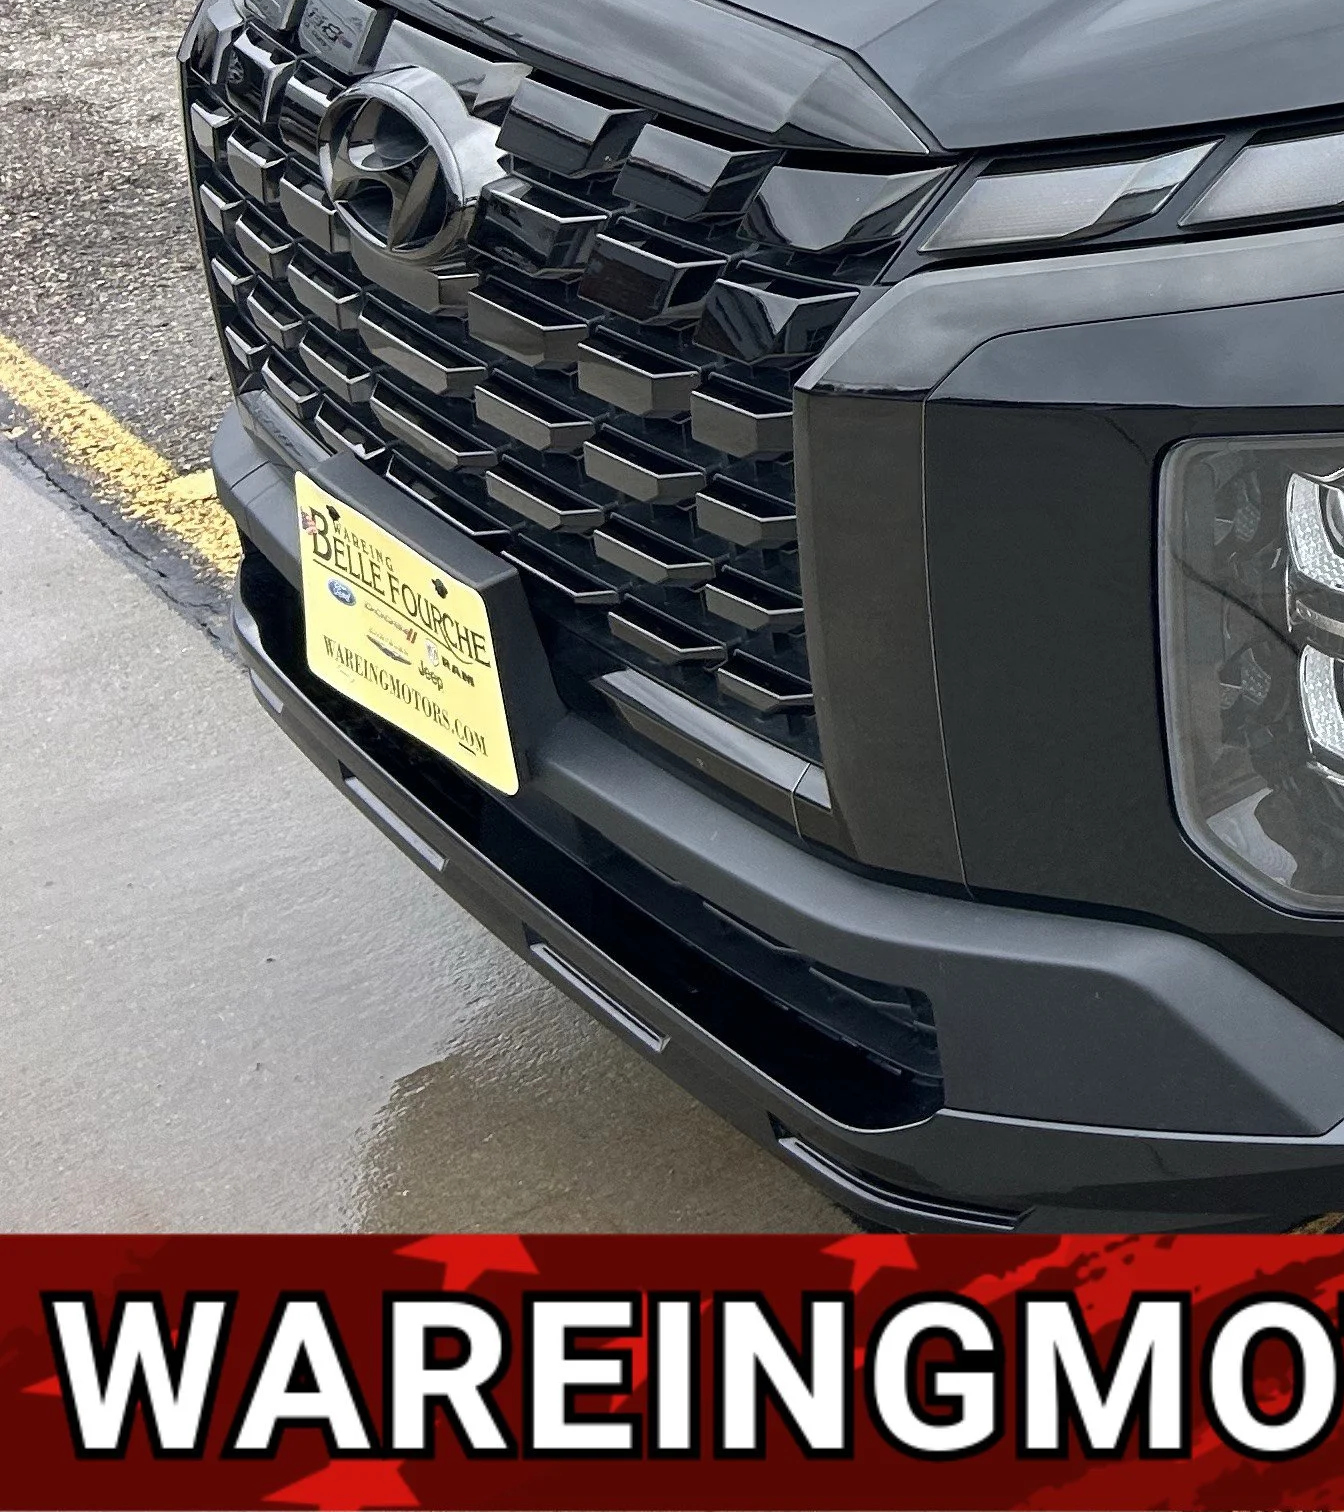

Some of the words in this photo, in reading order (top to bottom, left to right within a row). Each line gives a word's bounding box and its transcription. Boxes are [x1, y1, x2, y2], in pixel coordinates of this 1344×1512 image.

[333, 521, 394, 572] WAREING
[310, 506, 386, 596] BELLE
[388, 571, 492, 668] FOURCHE
[323, 634, 488, 758] WAREINGMOTORS.COM
[418, 660, 444, 692] Jeep
[441, 655, 476, 687] RAM
